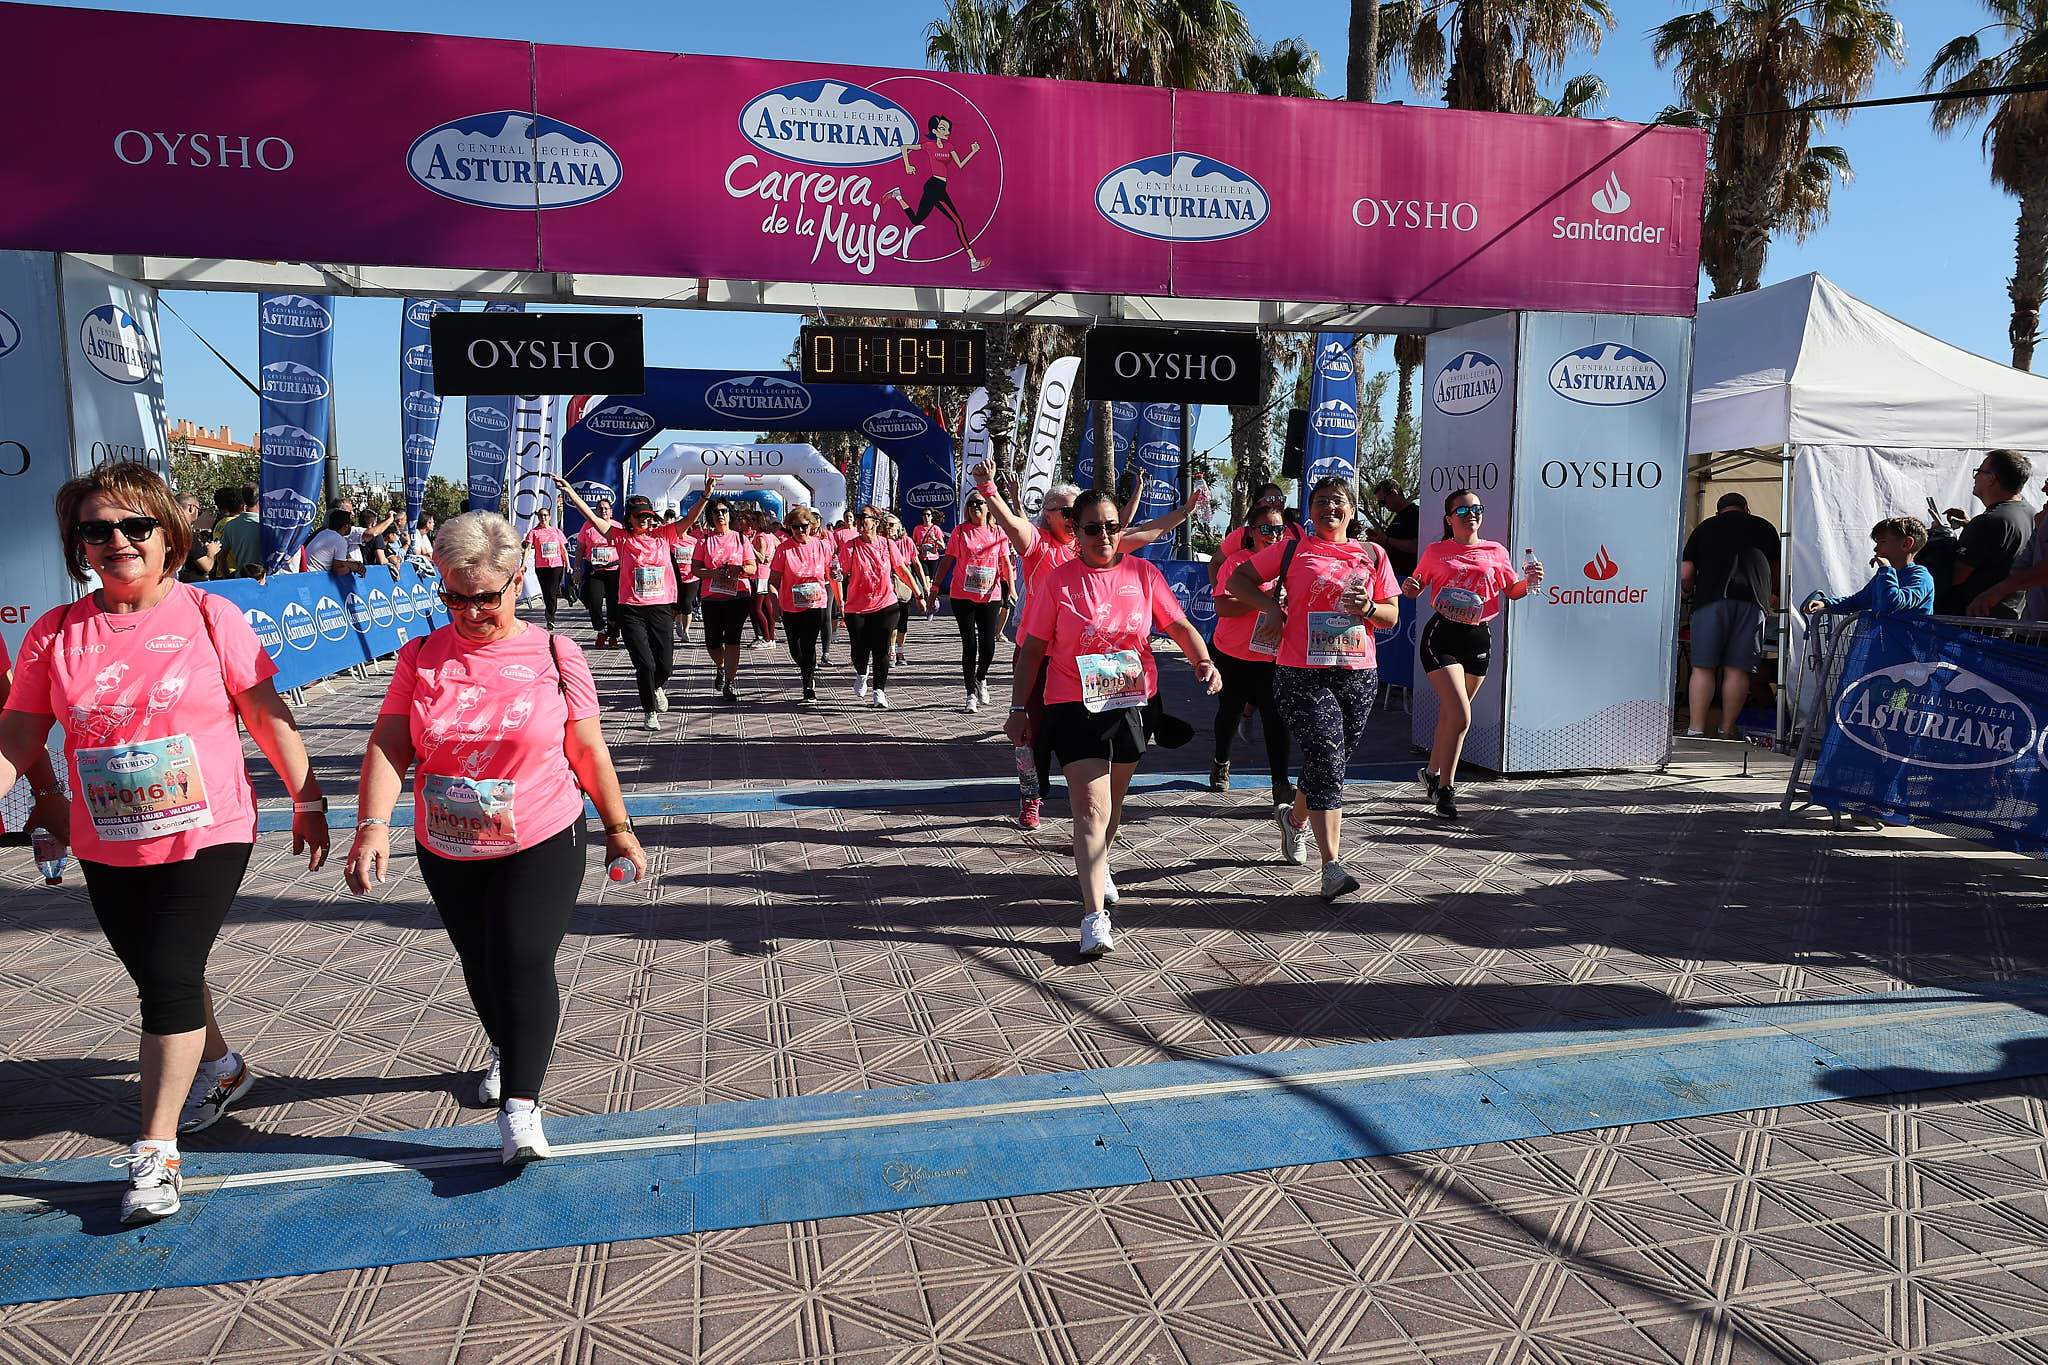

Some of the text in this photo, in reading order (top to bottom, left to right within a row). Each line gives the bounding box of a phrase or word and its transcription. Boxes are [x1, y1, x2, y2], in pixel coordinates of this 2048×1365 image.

[754, 106, 904, 147] ASTURIANA
[782, 106, 901, 122] CENTRAL LECHERA
[113, 129, 295, 172] OYSHO
[457, 142, 599, 158] CENTRAL LECHERA
[424, 143, 607, 186] ASTURIANA
[724, 154, 871, 206] Carrera
[1136, 181, 1251, 194] CENTRAL LECHERA
[1109, 181, 1257, 220] ASTURIANA
[1352, 198, 1478, 231] OYSHO
[762, 203, 926, 275] de la Mujer
[1552, 216, 1665, 244] Santander
[86, 324, 150, 369] ASTURIANA
[467, 338, 616, 371] OYSHO
[814, 335, 972, 376] 01:10:41
[1114, 351, 1237, 381] OYSHO
[1556, 365, 1657, 391] ASTURIANA
[1575, 364, 1655, 373] CENTRAL LECHERA
[713, 388, 804, 408] ASTURIANA
[1436, 377, 1497, 403] ASTURIANA
[591, 417, 649, 430] ASTURIANA
[868, 421, 924, 433] ASTURIANA
[701, 449, 783, 467] OYSHO
[1025, 380, 1066, 514] OYSHO
[1142, 448, 1180, 463] ASTURIAN
[1430, 462, 1499, 493] OYSHO
[1541, 460, 1662, 489] OYSHO
[1549, 586, 1648, 605] Santander
[1882, 687, 2016, 722] CENTRAL LECHERA
[1845, 688, 2014, 753] ASTURIANA
[110, 756, 155, 770] ASTURIANA
[119, 783, 165, 804] 016
[141, 811, 164, 822] MUJER
[169, 803, 201, 816] VALENCIA
[105, 826, 139, 837] OYSHO
